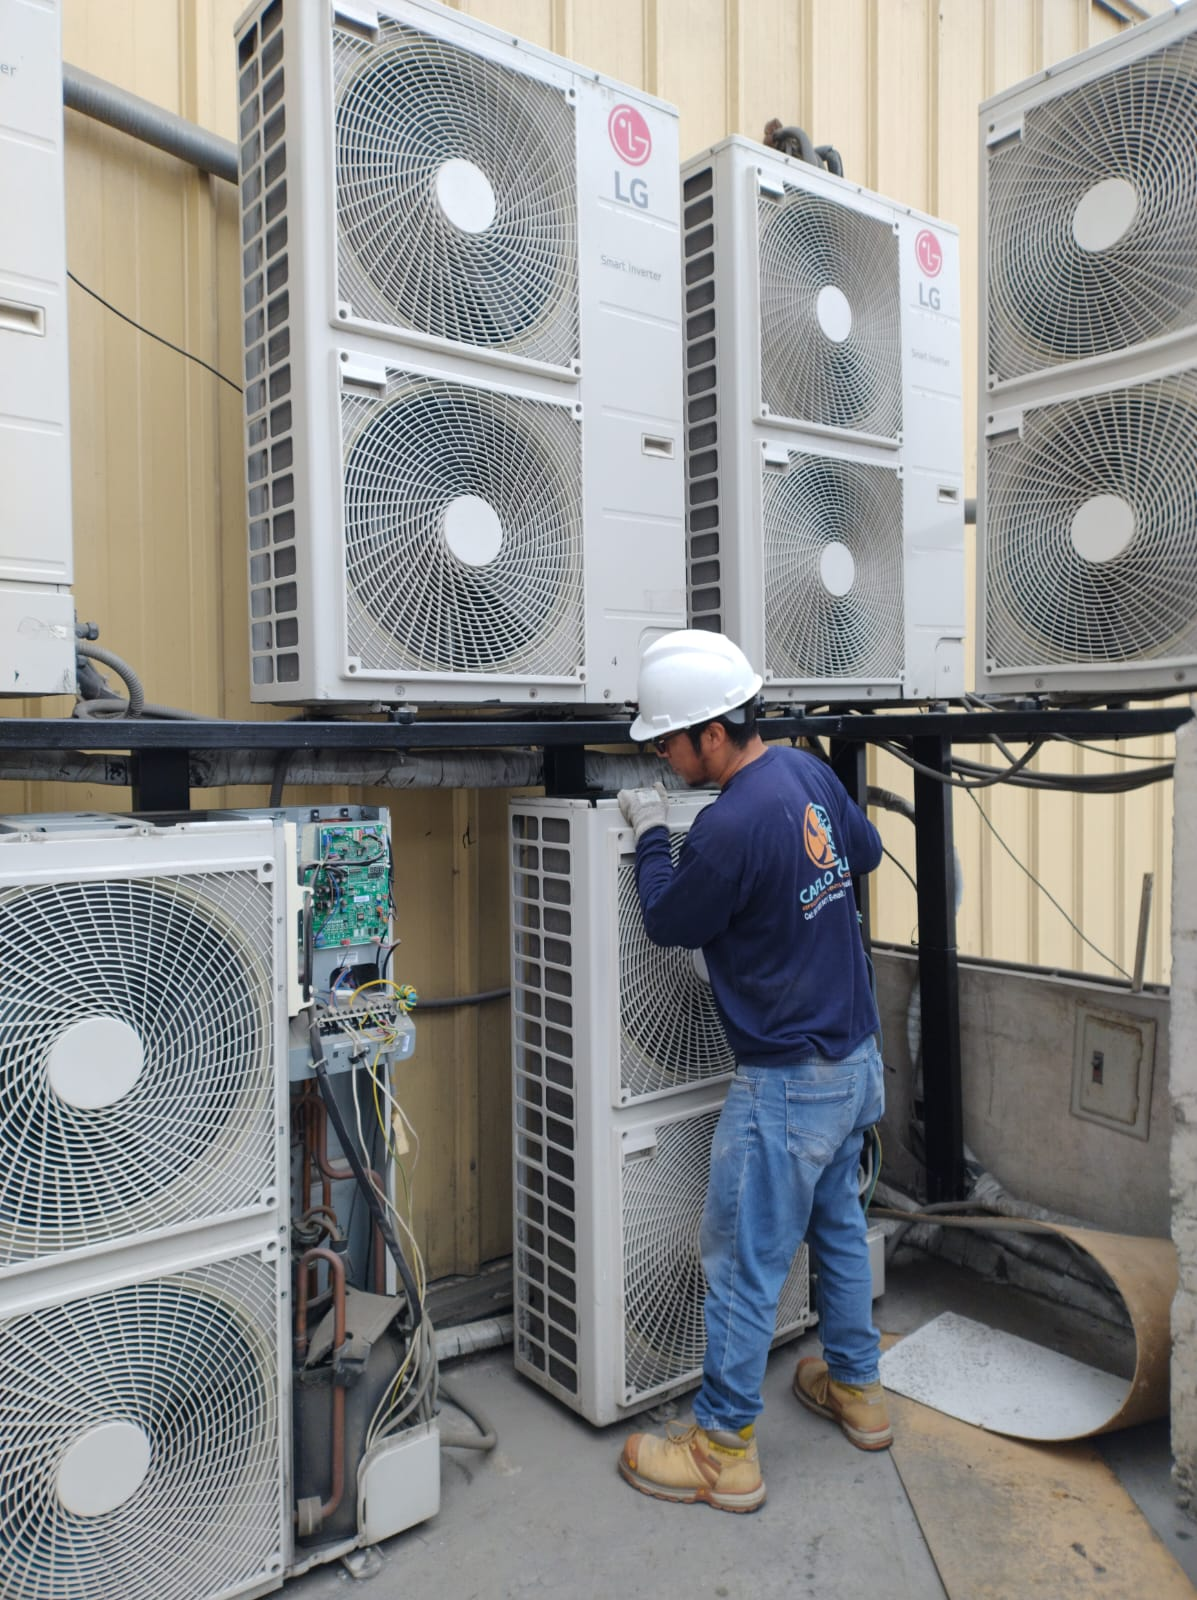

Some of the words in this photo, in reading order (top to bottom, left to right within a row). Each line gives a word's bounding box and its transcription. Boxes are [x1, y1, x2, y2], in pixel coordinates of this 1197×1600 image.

[615, 170, 648, 208] LG
[601, 254, 626, 272] Smart
[628, 264, 662, 281] Inverter
[919, 282, 940, 310] LG
